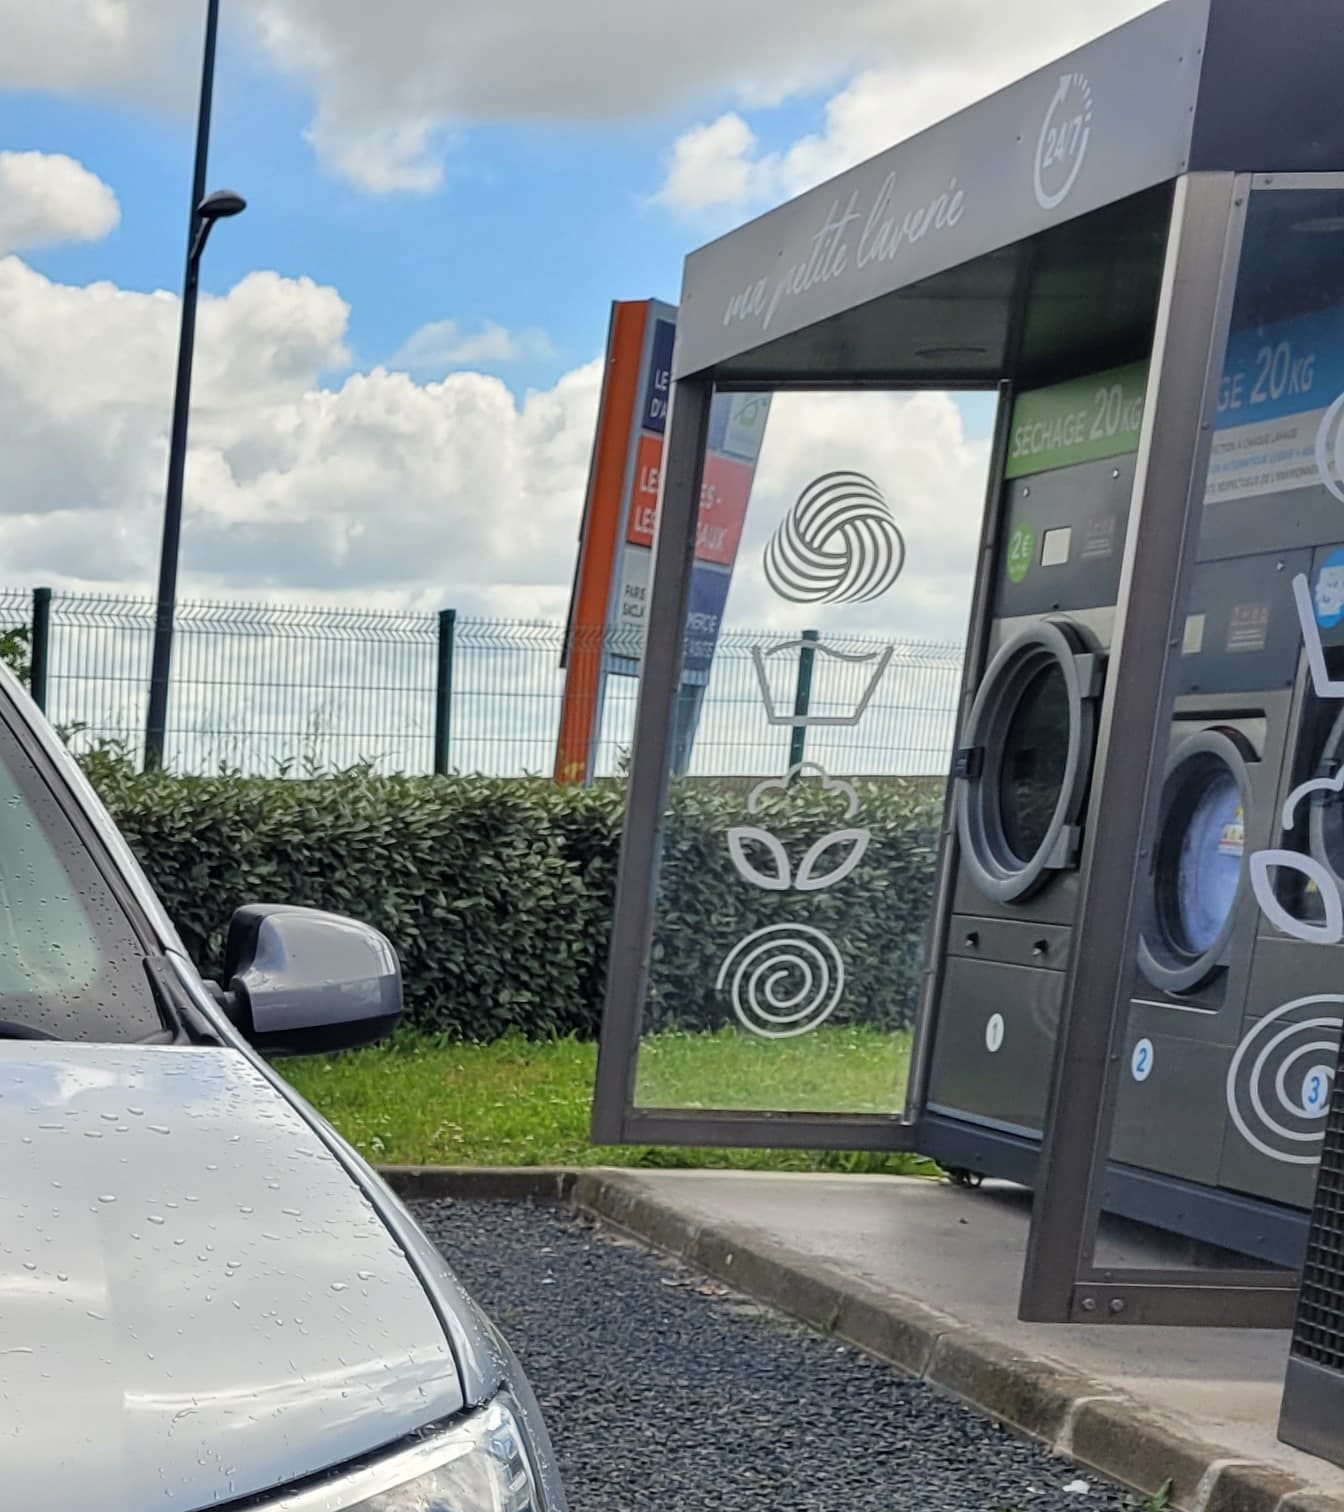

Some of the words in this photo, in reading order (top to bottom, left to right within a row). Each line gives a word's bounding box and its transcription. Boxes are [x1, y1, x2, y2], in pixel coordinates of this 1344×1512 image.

[1043, 114, 1083, 168] 24/7
[723, 276, 768, 326] ma
[990, 1022, 998, 1045] 1
[1135, 1048, 1148, 1073] 2
[1308, 1076, 1321, 1104] 3
